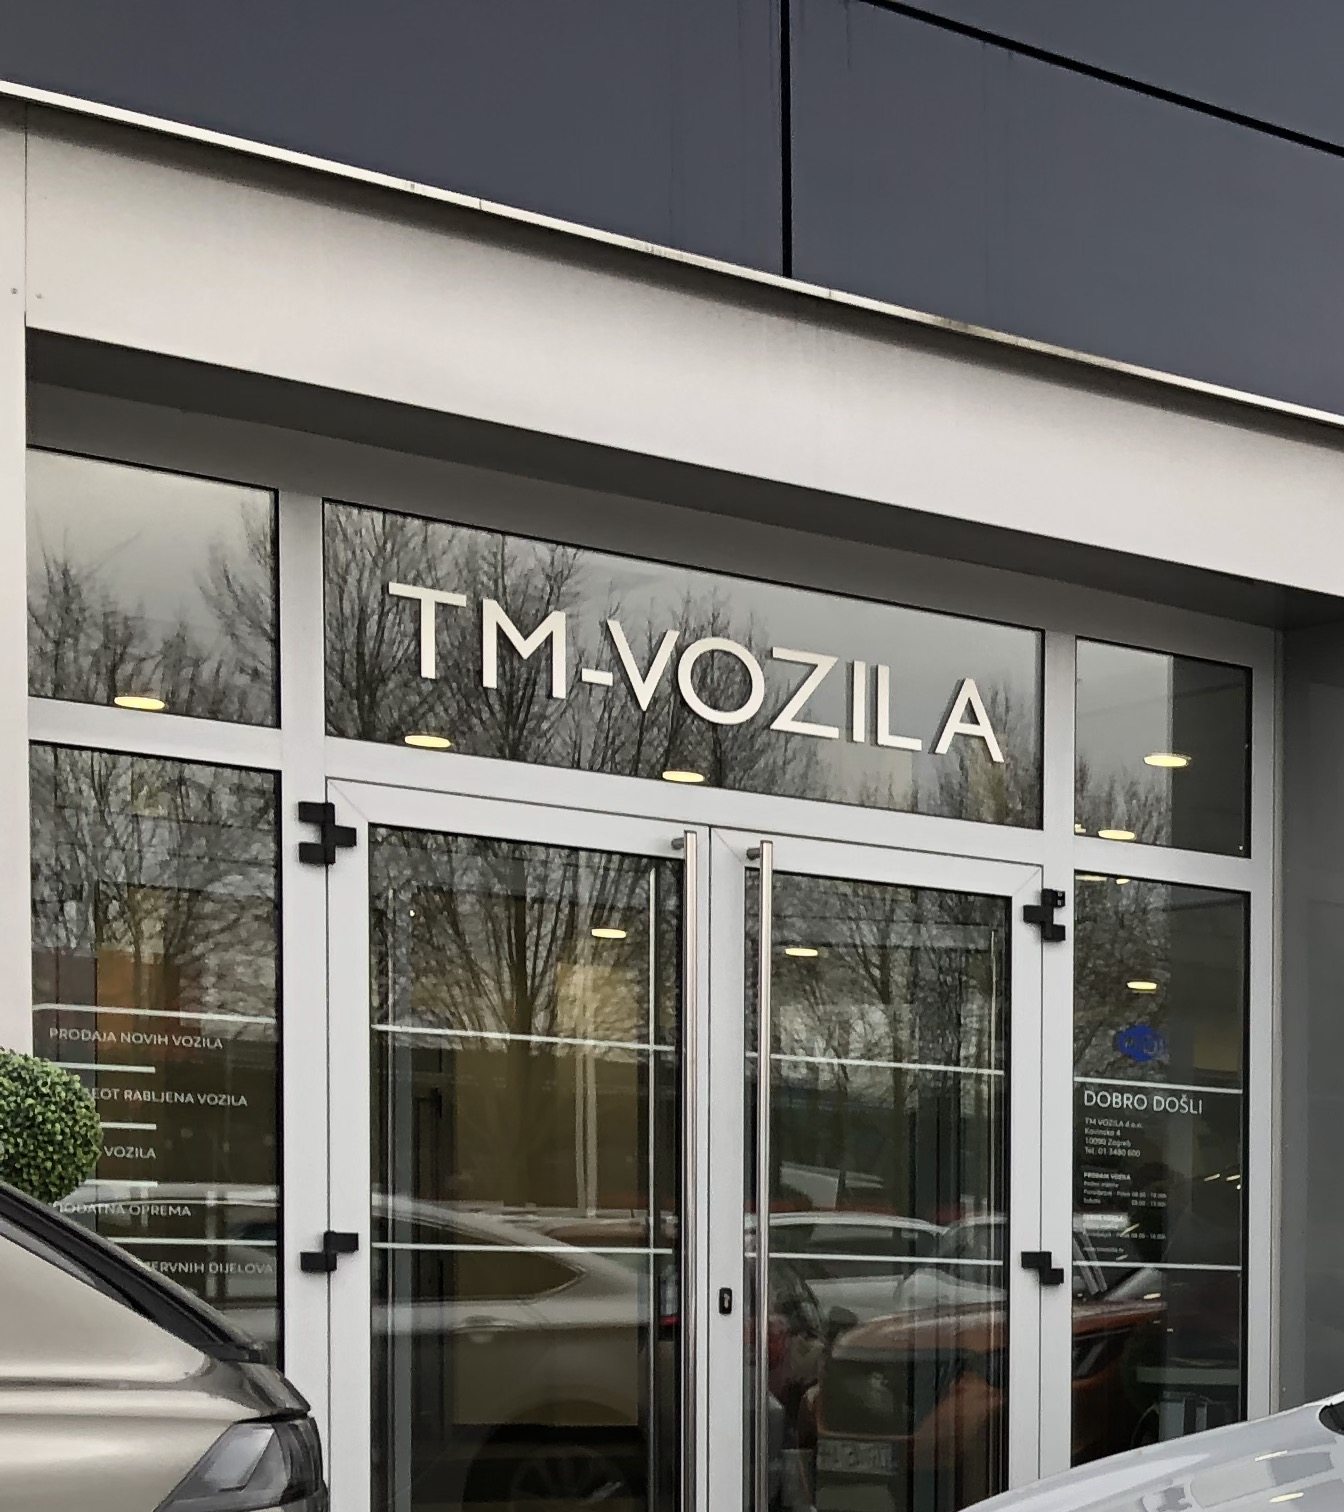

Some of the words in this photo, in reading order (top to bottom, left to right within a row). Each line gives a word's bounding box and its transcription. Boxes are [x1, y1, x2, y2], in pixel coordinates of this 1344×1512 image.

[388, 581, 1004, 764] TM-VOZILA
[50, 1027, 117, 1043] PRODAJA
[121, 1032, 169, 1045] NOVIH
[171, 1035, 223, 1049] VOZILA
[124, 1089, 194, 1104] RABLJENA
[197, 1093, 248, 1106] VOZILA
[1084, 1090, 1148, 1110] DOBRO
[1152, 1094, 1203, 1115] DOŠLI
[104, 1145, 157, 1159] VOZILA
[131, 1204, 192, 1217] OPREMA
[208, 1261, 273, 1274] DIJELOVA
